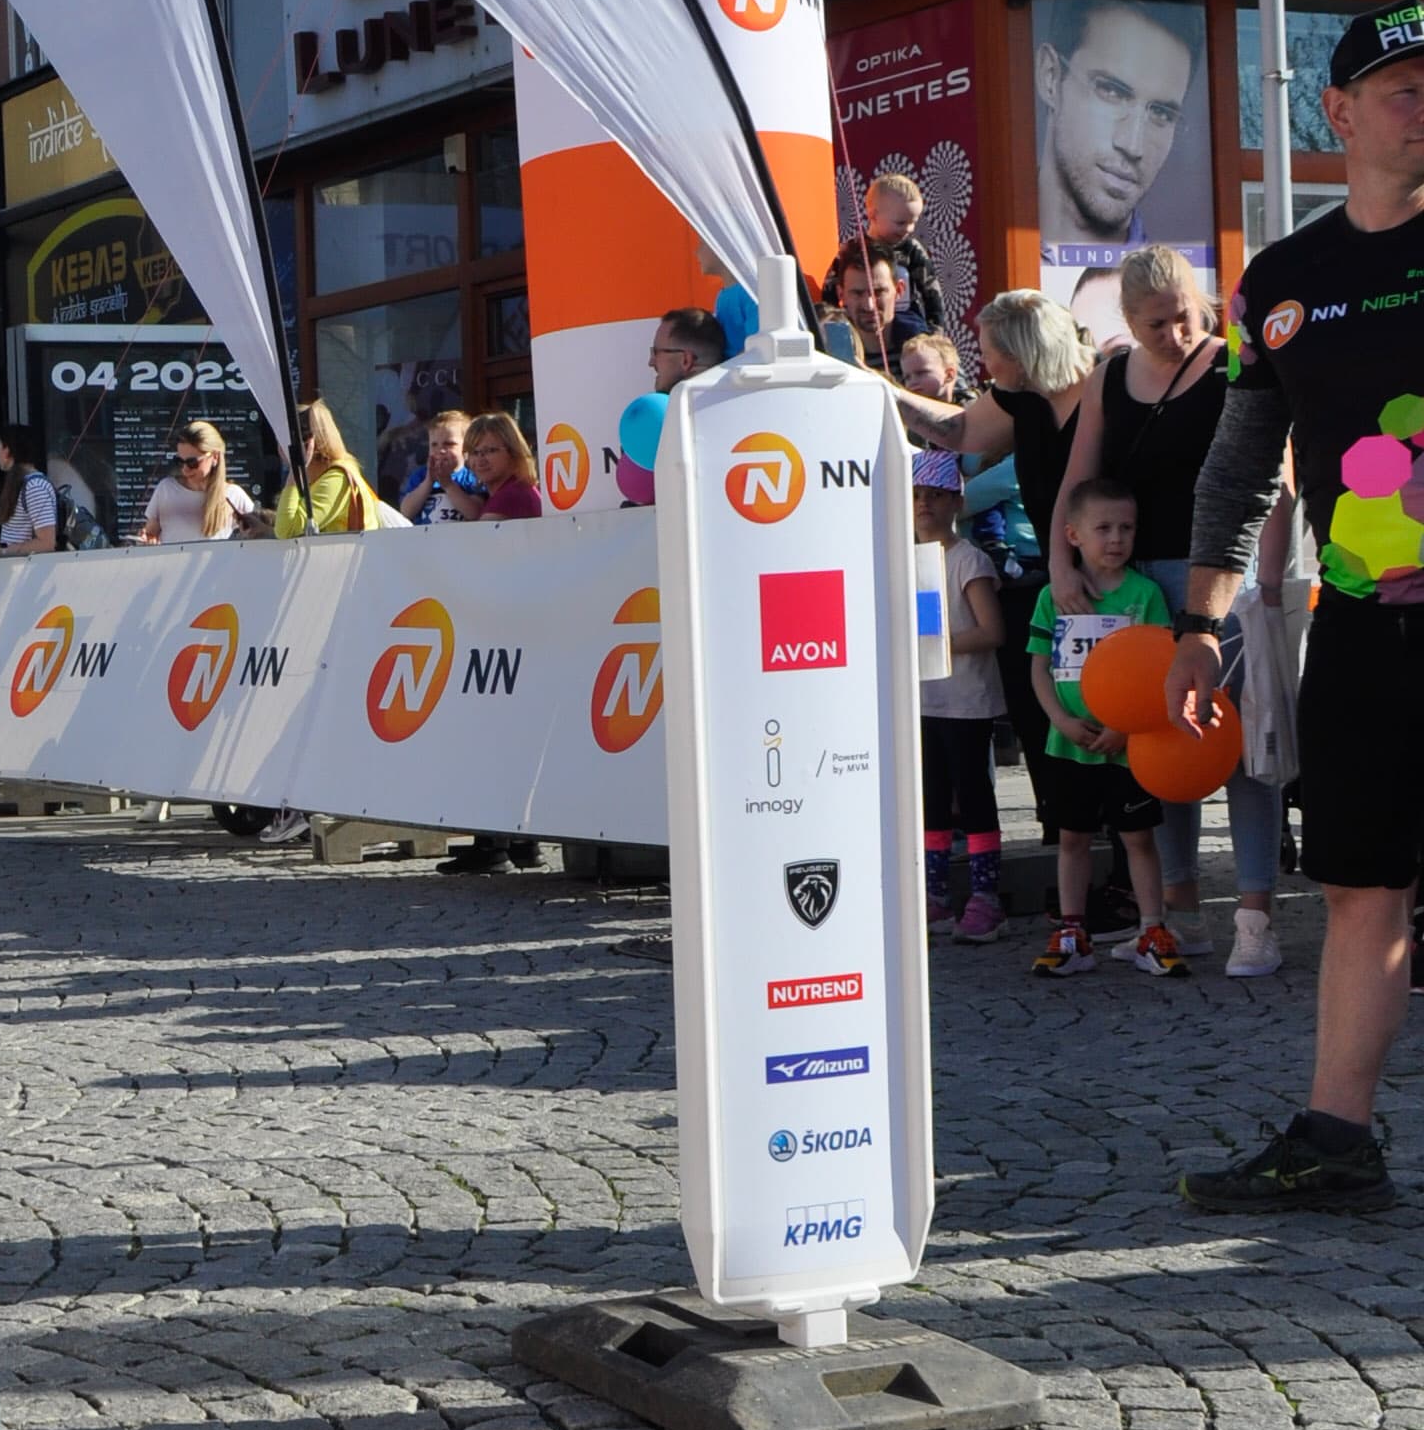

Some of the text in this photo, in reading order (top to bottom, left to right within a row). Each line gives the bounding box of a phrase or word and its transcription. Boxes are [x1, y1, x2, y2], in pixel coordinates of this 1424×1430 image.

[856, 44, 923, 72] OPTIKA
[1311, 302, 1347, 324] NN
[51, 360, 249, 393] 04 2023
[821, 459, 871, 490] NN
[439, 508, 465, 521] 32
[70, 642, 117, 679] NN
[771, 640, 838, 664] AVON
[239, 646, 289, 688] NN
[462, 647, 522, 696] NN
[832, 751, 869, 762] Powered
[832, 762, 869, 776] by MVM
[745, 797, 804, 815] innogy
[772, 978, 860, 1004] NUTREND
[801, 1126, 873, 1155] ŠKODA
[783, 1215, 863, 1247] KPMG
